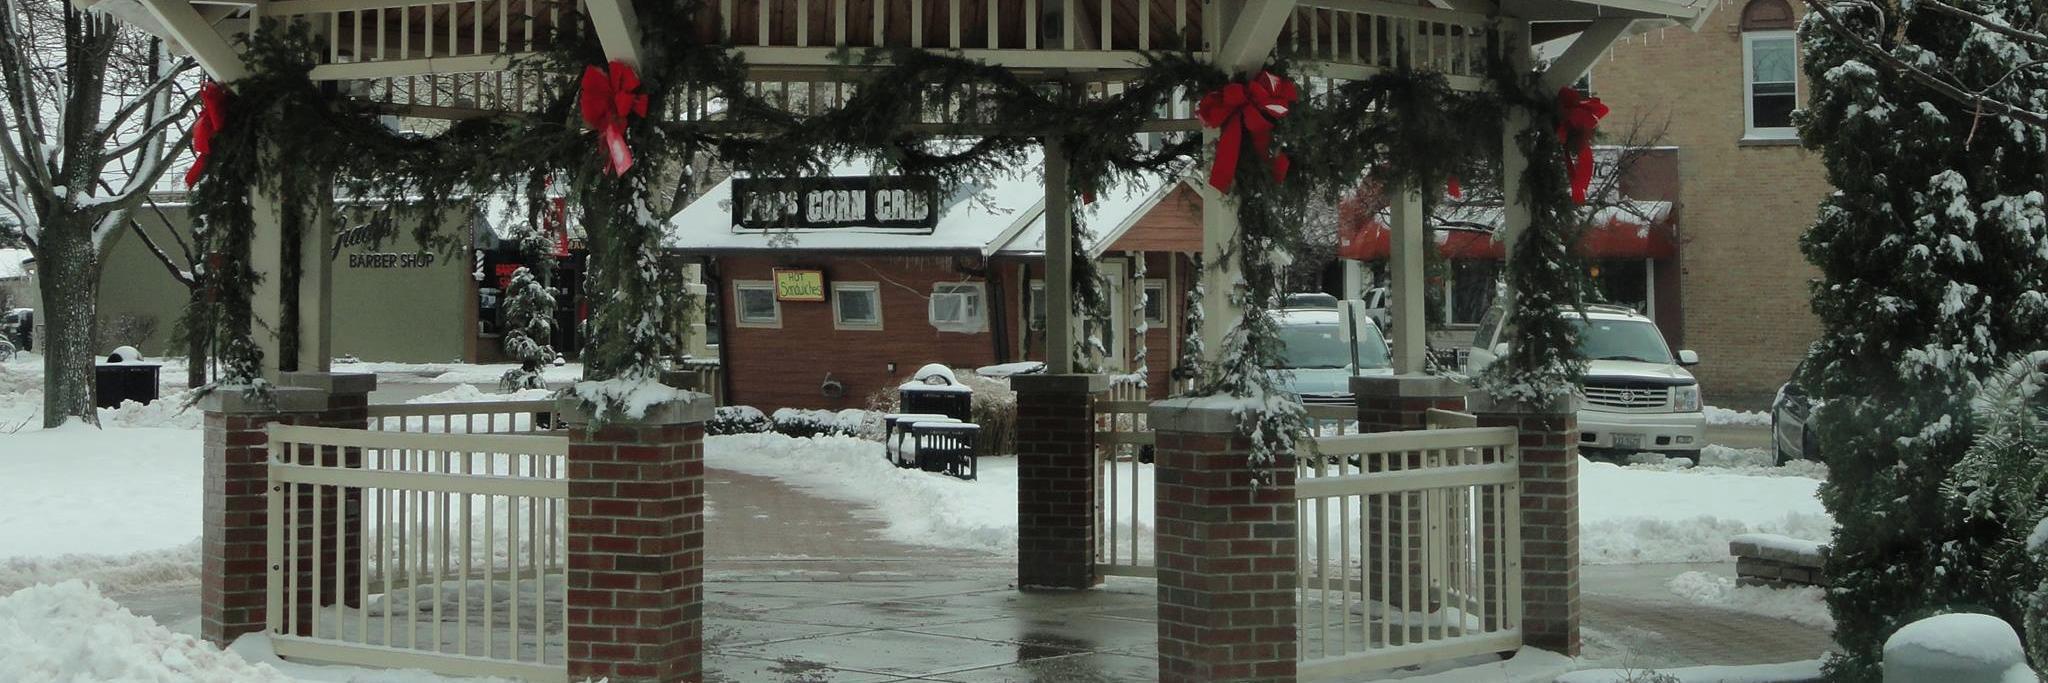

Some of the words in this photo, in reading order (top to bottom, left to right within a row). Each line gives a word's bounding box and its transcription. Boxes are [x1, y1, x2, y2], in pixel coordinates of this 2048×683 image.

[806, 189, 866, 222] CORN
[875, 189, 929, 222] CRIB
[349, 252, 397, 268] BARBER
[400, 252, 434, 268] SHOP
